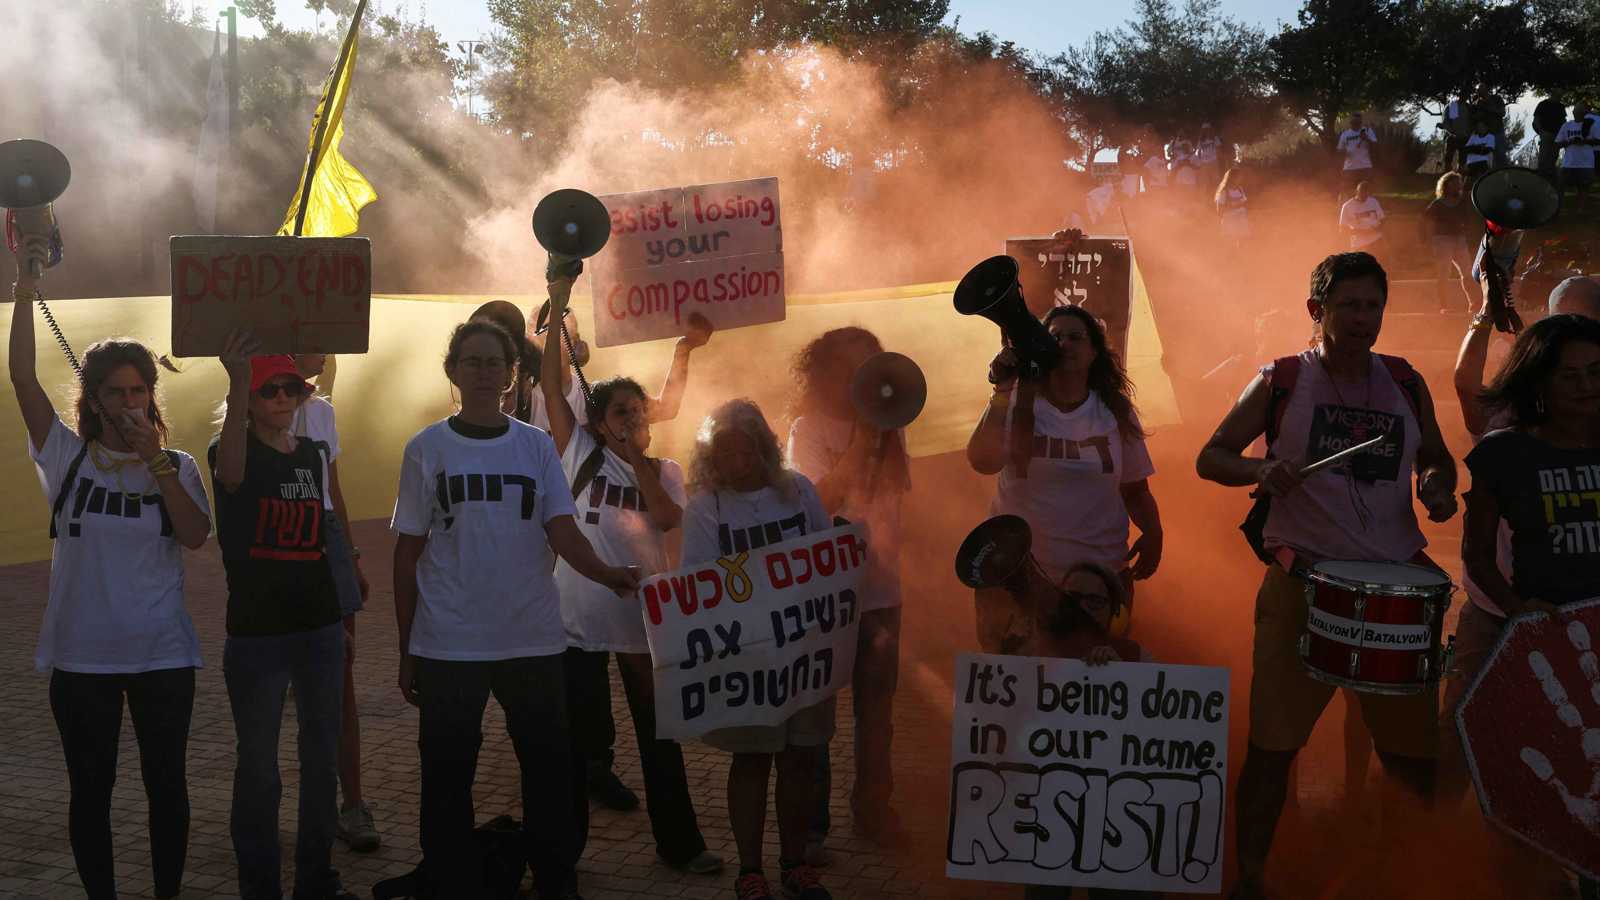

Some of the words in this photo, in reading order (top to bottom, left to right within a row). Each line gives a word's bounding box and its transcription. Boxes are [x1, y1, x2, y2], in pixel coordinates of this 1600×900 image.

[610, 199, 678, 236] esist
[694, 195, 776, 226] losing
[646, 230, 730, 265] your
[177, 250, 287, 305] DEAD
[608, 267, 780, 325] compassion
[1319, 434, 1398, 458] HOSAGE
[1538, 467, 1572, 493] הם
[256, 498, 321, 548] כשיו
[643, 551, 753, 625] עכשיו
[766, 534, 860, 590] הסכם
[680, 620, 742, 669] את
[771, 589, 857, 648] השיבו
[681, 648, 833, 721] החטופים
[964, 662, 1017, 708] It's
[1036, 664, 1129, 721] being
[1141, 671, 1224, 723] done
[969, 717, 1007, 754] in
[1028, 728, 1108, 759] our
[1121, 733, 1224, 770] name.
[947, 761, 1224, 884] RESIST!
